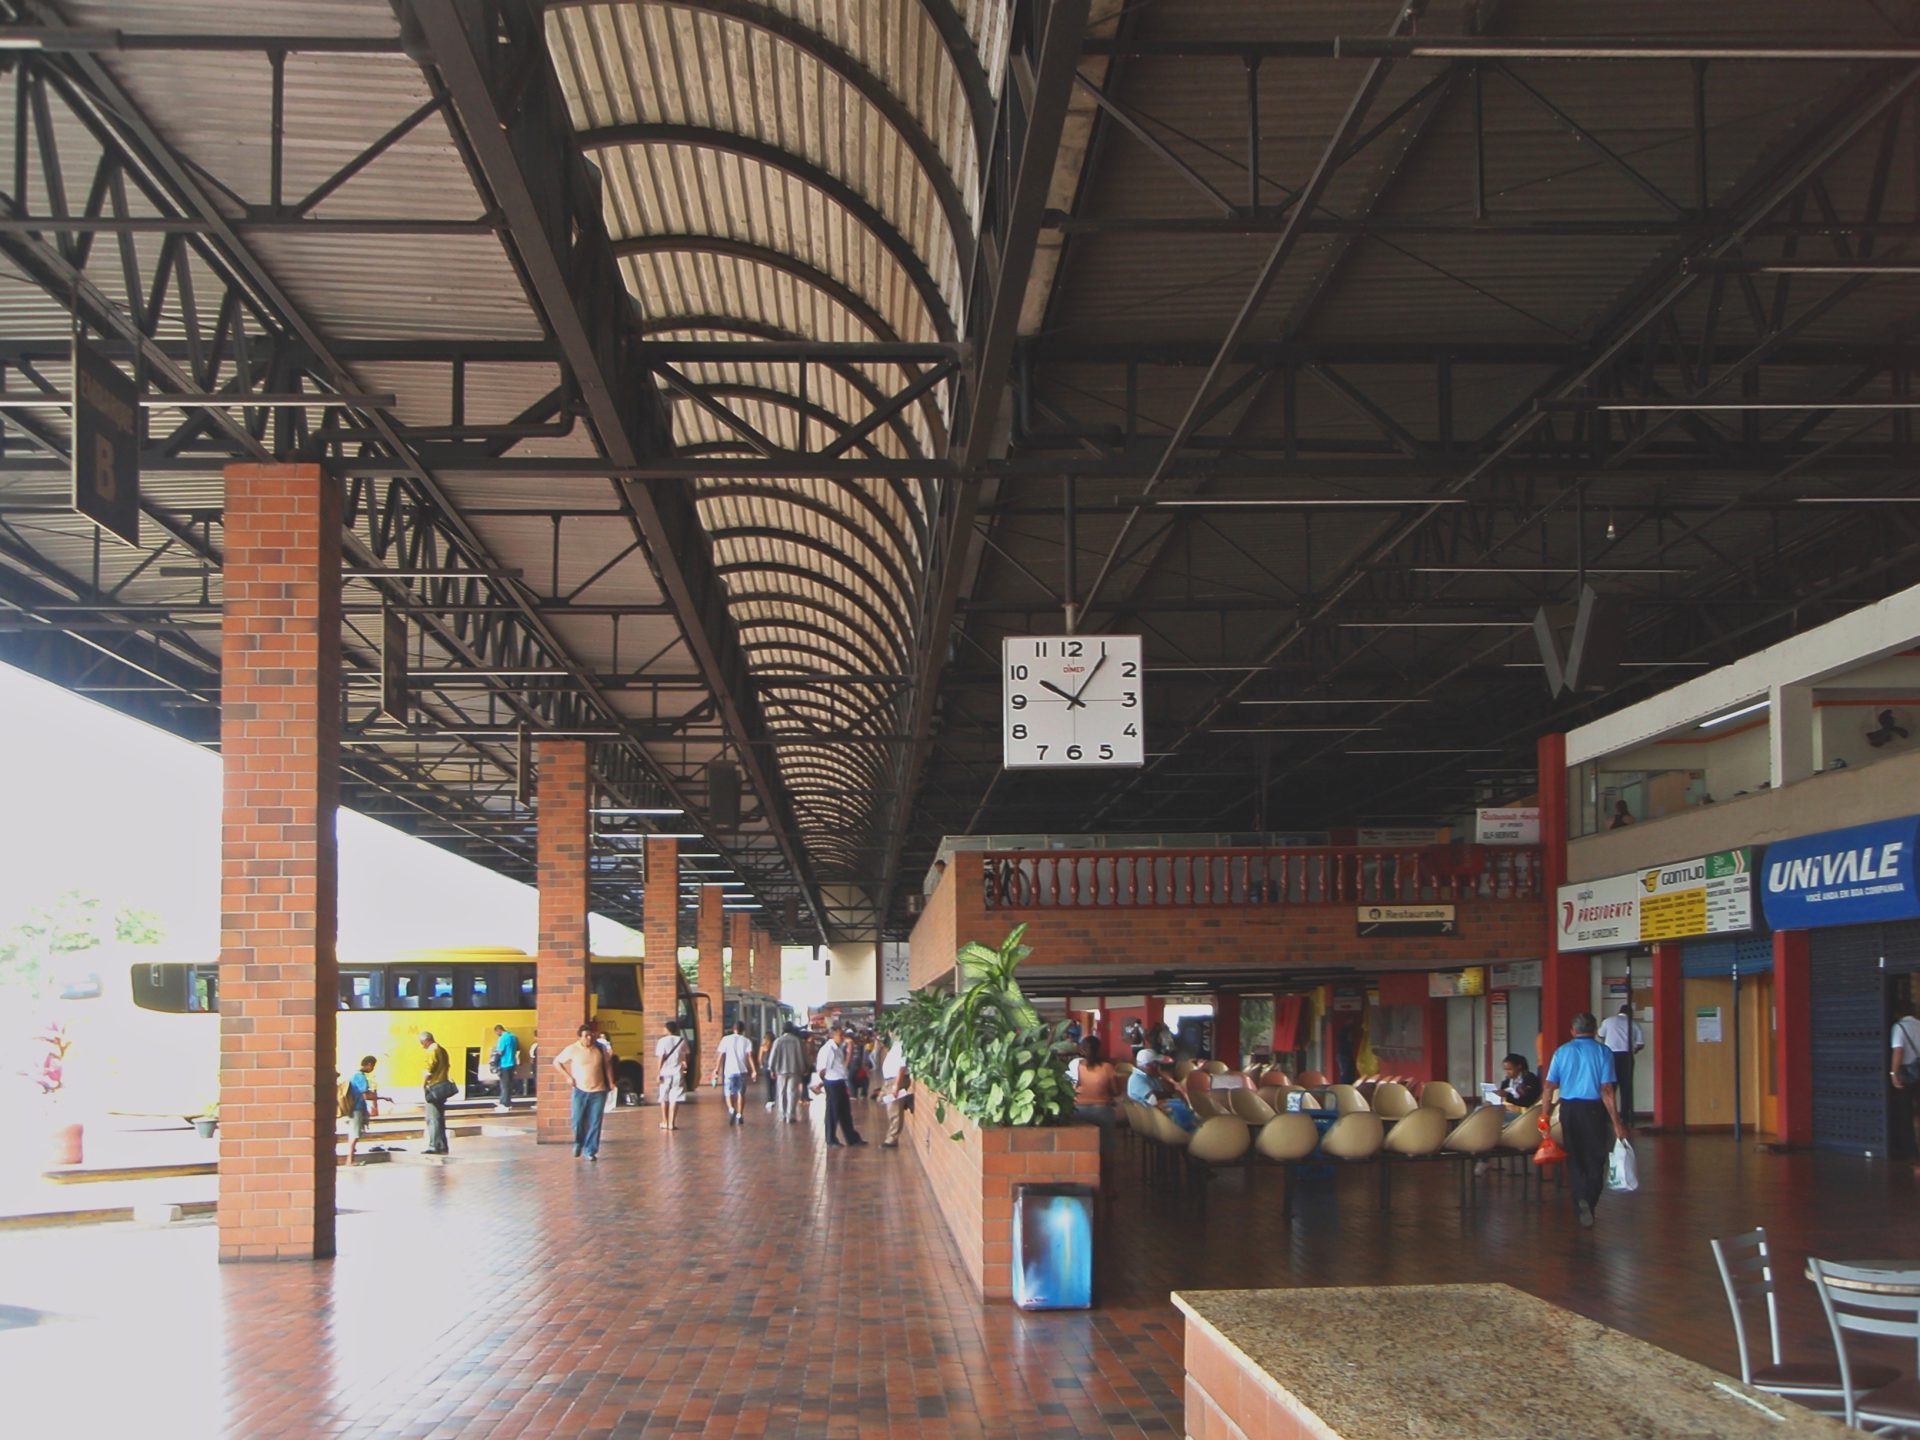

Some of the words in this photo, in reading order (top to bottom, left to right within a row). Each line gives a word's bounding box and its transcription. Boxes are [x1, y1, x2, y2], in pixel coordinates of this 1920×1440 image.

[1036, 641, 1047, 658] 11
[1061, 641, 1083, 658] 12
[1010, 665, 1029, 681] 10
[1121, 662, 1137, 678] 2
[1011, 694, 1028, 710] 9
[1121, 692, 1137, 708] 3
[1012, 724, 1028, 740] 8
[1123, 723, 1137, 738] 4
[1036, 745, 1049, 760] 7
[1066, 745, 1083, 760] 6
[1098, 744, 1114, 760] 5
[1661, 865, 1705, 886] GONTIJO
[1385, 909, 1446, 919] Restaurante
[1578, 901, 1633, 922] PRESIDENTE
[1592, 927, 1619, 939] HORIZONTE
